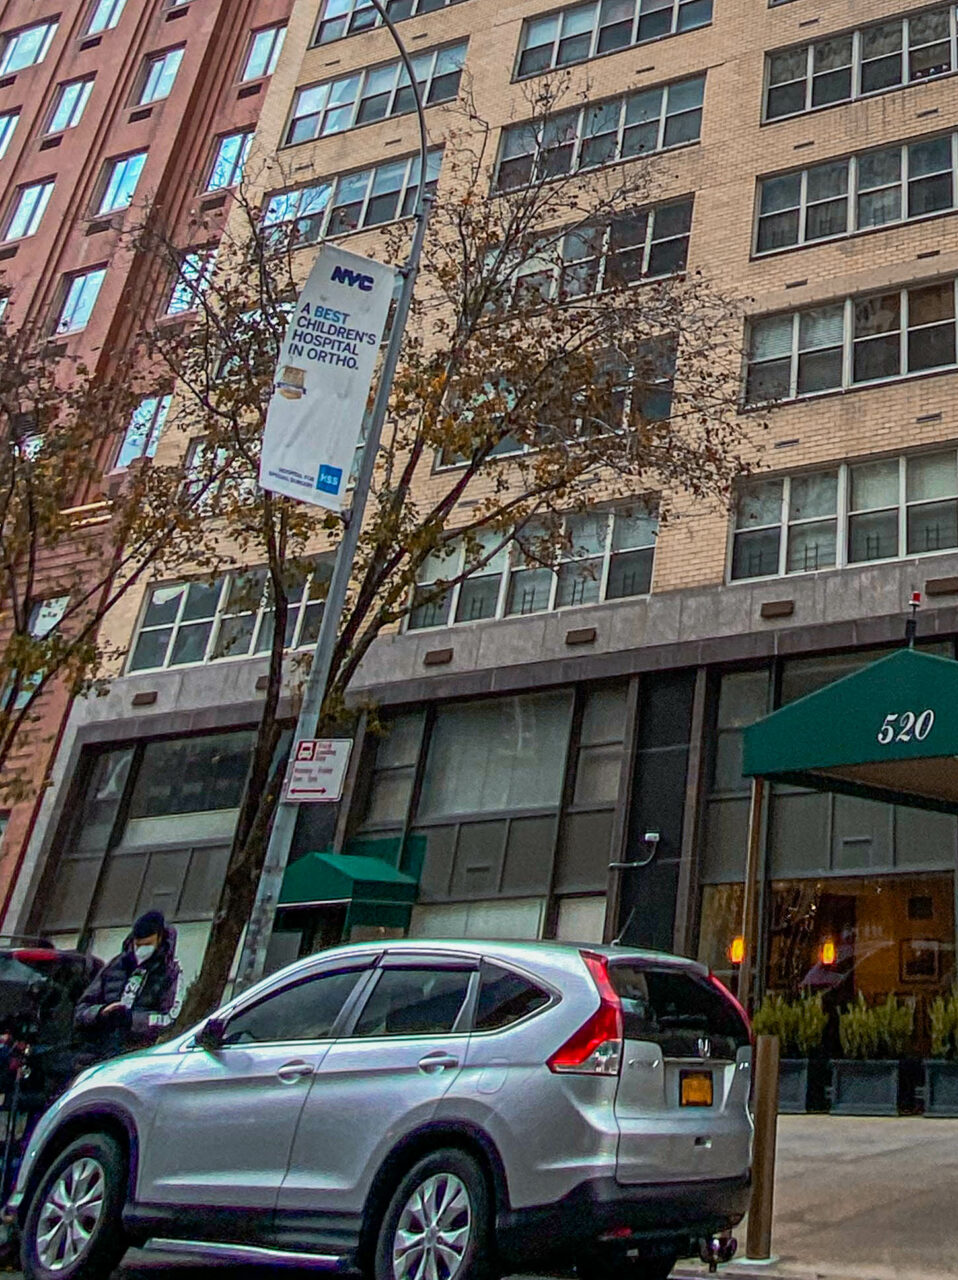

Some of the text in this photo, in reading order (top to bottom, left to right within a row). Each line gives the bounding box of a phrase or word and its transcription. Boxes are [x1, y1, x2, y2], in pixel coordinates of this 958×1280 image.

[331, 266, 374, 292] NYC
[300, 302, 350, 325] A BEST
[292, 329, 359, 356] HOSPITAL
[297, 316, 376, 345] CHILDREN'S
[288, 342, 359, 370] IN ORTHO.
[877, 709, 935, 744] 520
